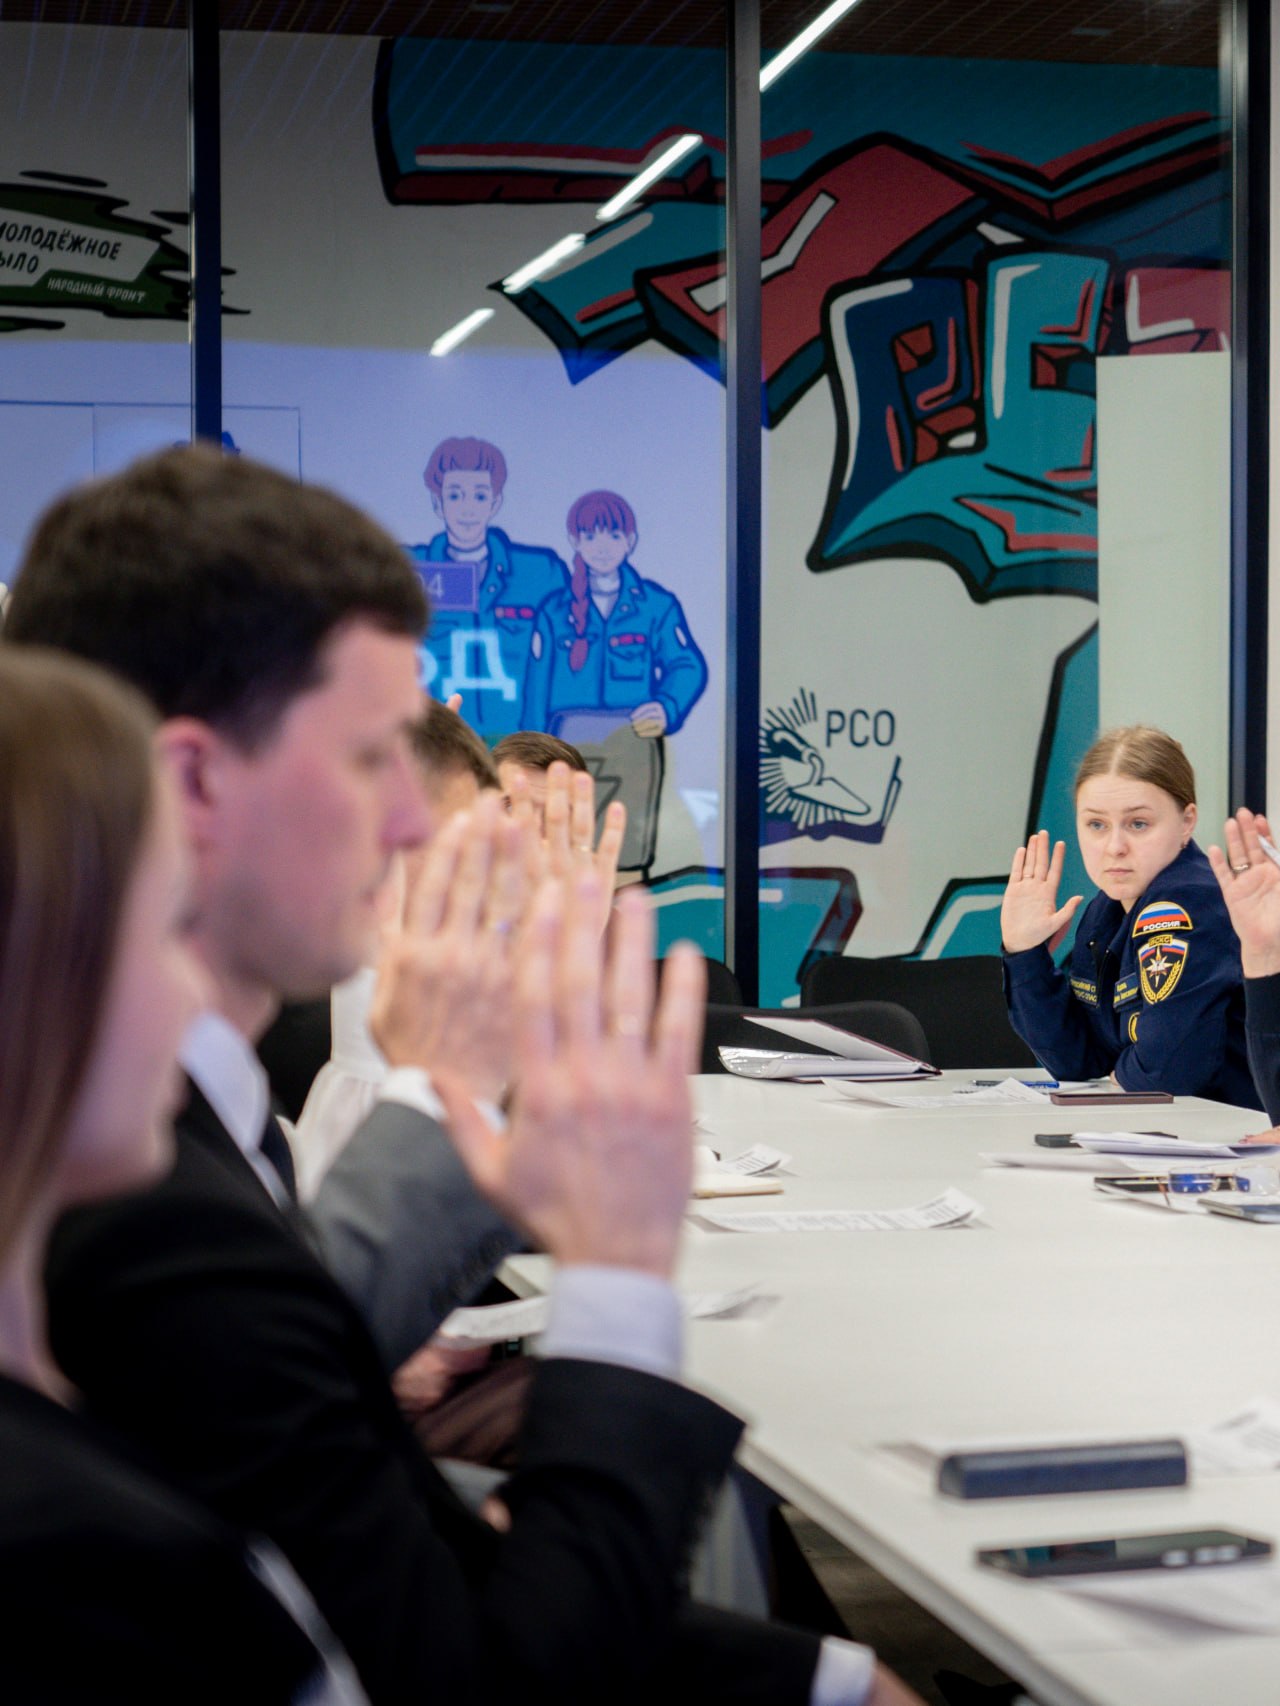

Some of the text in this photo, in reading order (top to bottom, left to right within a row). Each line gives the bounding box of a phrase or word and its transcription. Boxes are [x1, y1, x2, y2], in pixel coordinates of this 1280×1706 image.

[47, 278, 147, 303] НАРОДНЫЙ ФРОНТ
[826, 708, 896, 748] РСО
[1143, 920, 1181, 932] РОССИЯ
